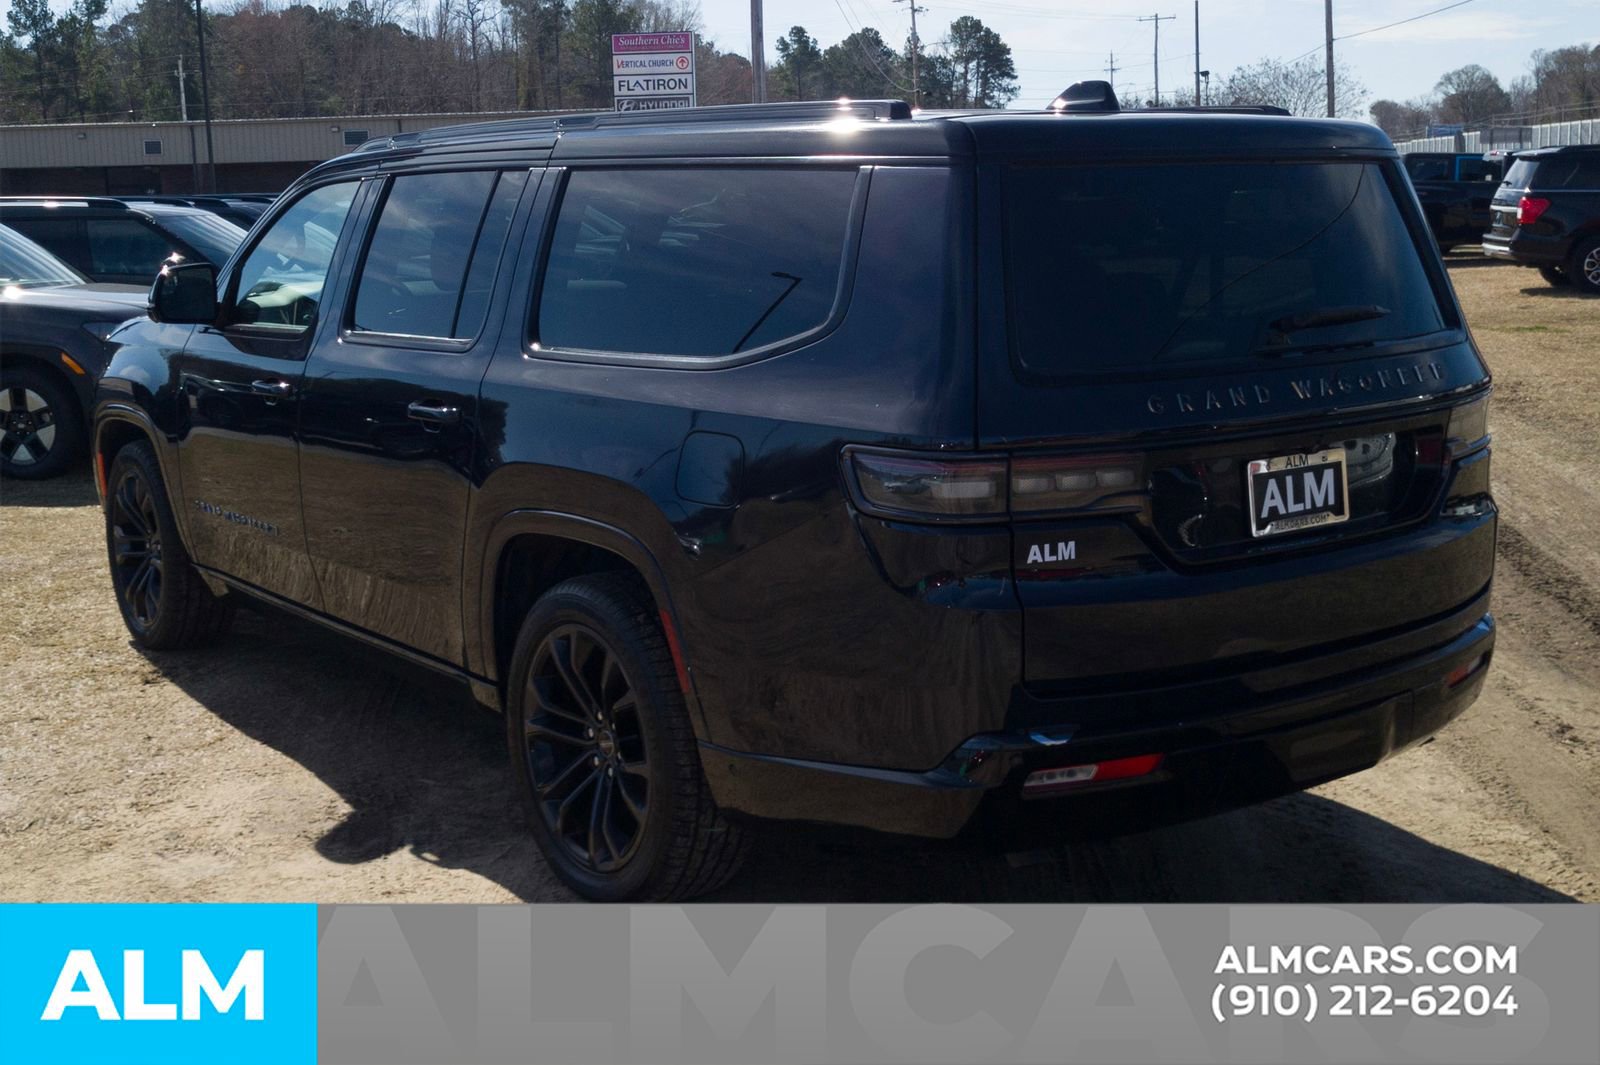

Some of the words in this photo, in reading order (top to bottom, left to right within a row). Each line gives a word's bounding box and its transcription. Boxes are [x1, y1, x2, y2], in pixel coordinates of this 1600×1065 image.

[618, 36, 659, 46] Southern
[616, 60, 647, 69] VERTICAL
[648, 59, 674, 68] CHURCH
[618, 78, 688, 92] FLATIRON
[1147, 384, 1270, 414] GRAND
[1285, 454, 1309, 468] ALM
[1261, 468, 1335, 519] ALM
[1027, 540, 1076, 564] ALM
